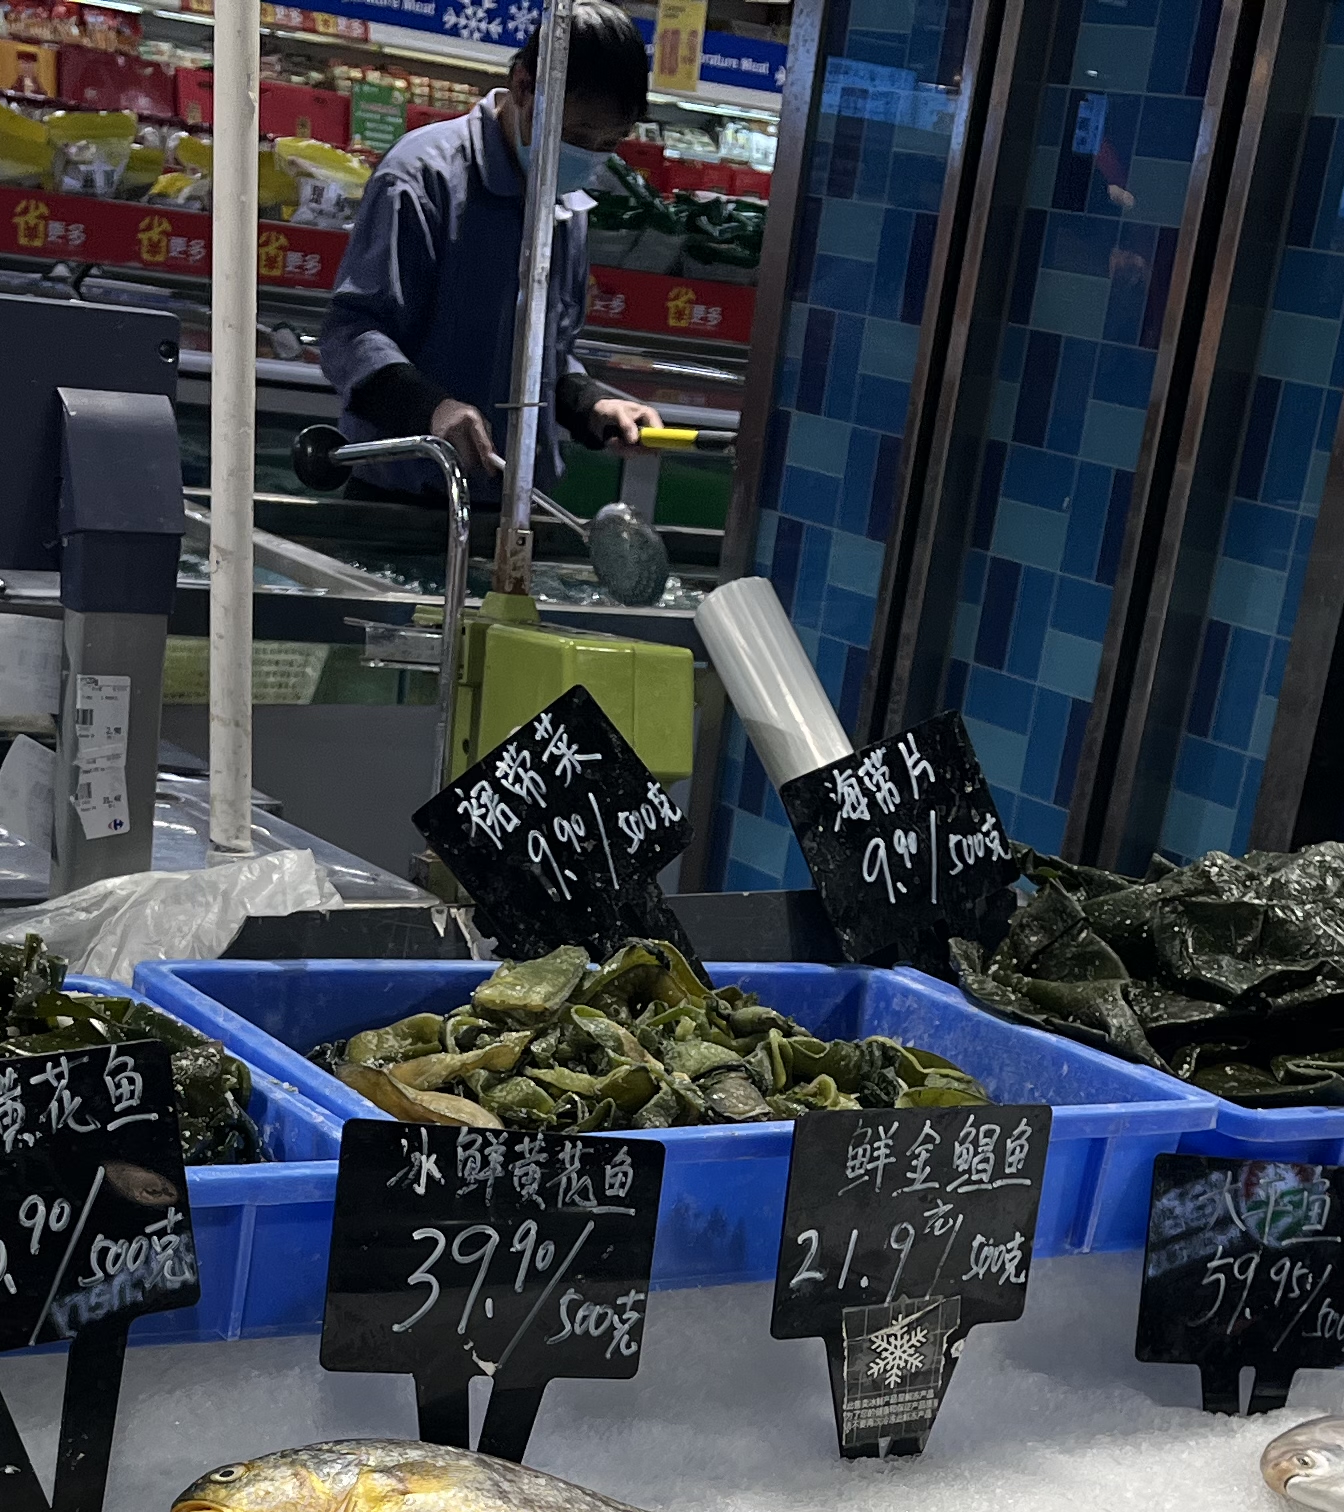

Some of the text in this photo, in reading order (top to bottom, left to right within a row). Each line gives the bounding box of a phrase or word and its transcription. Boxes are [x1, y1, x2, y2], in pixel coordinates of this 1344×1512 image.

[455, 712, 602, 850] 裙带菜
[830, 732, 936, 832] 海带片
[386, 1126, 636, 1217] 冰鲜黄花鱼
[837, 1113, 1032, 1197] 鲜金鲳鱼
